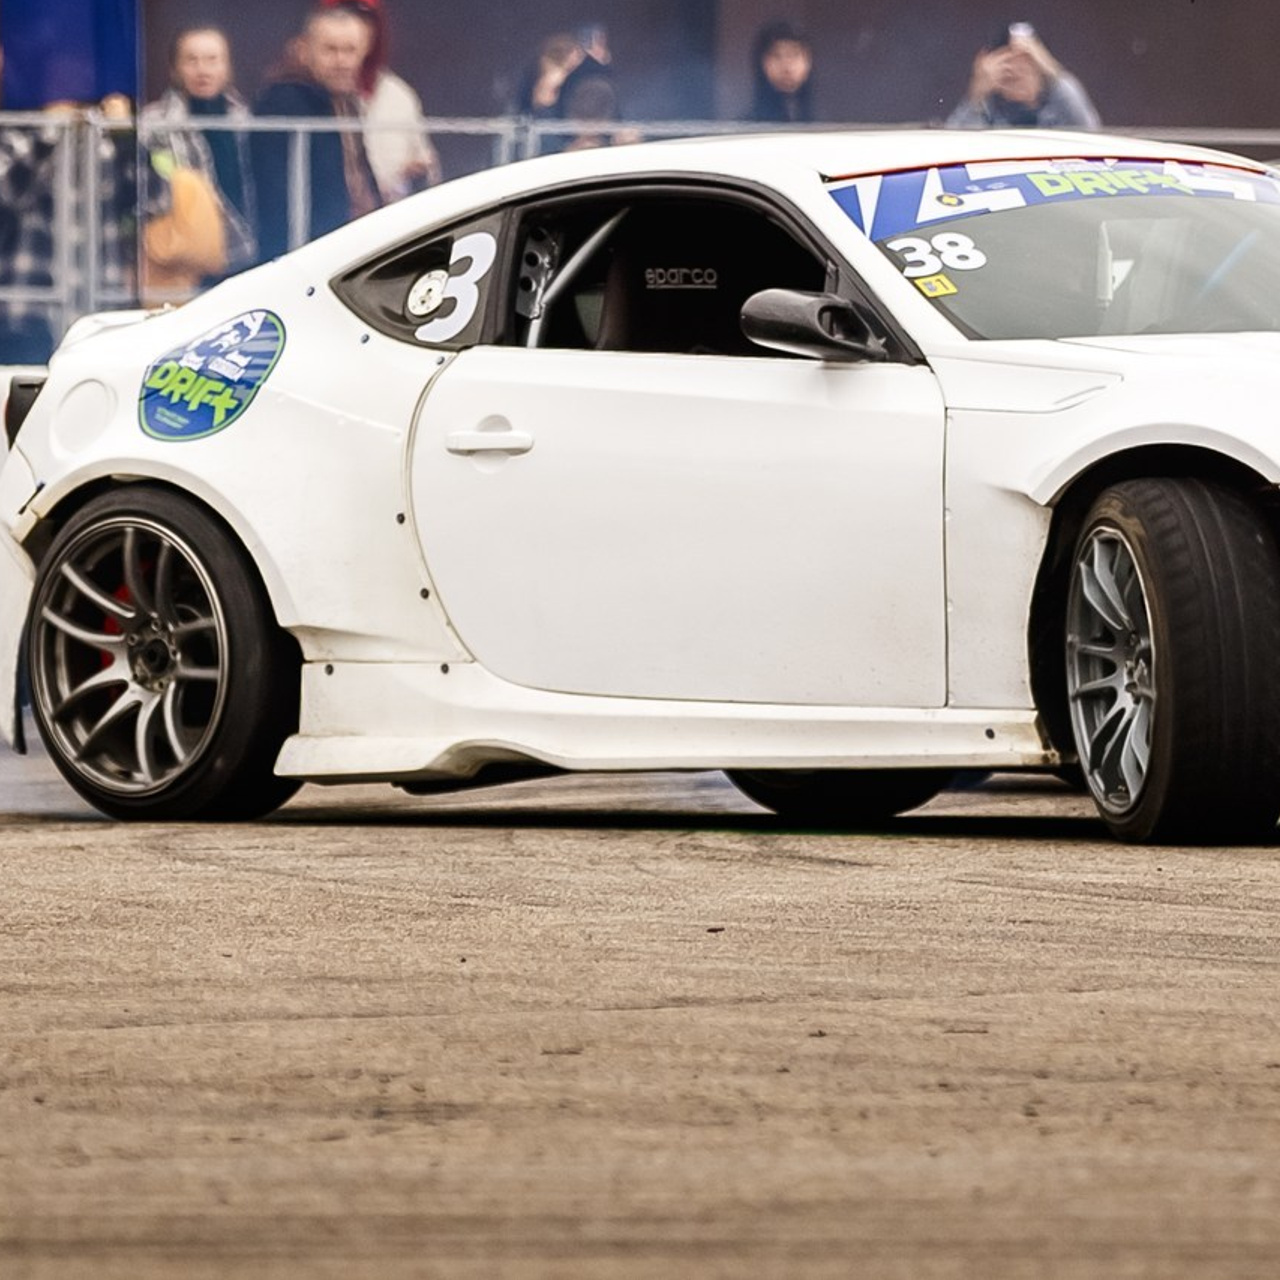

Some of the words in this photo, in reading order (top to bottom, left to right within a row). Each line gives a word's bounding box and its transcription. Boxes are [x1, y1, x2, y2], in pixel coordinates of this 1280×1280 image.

[1026, 169, 1194, 197] DRIFT
[886, 231, 987, 277] 38
[414, 231, 497, 343] 3
[645, 268, 717, 289] sparco
[145, 360, 238, 428] DRIFT
